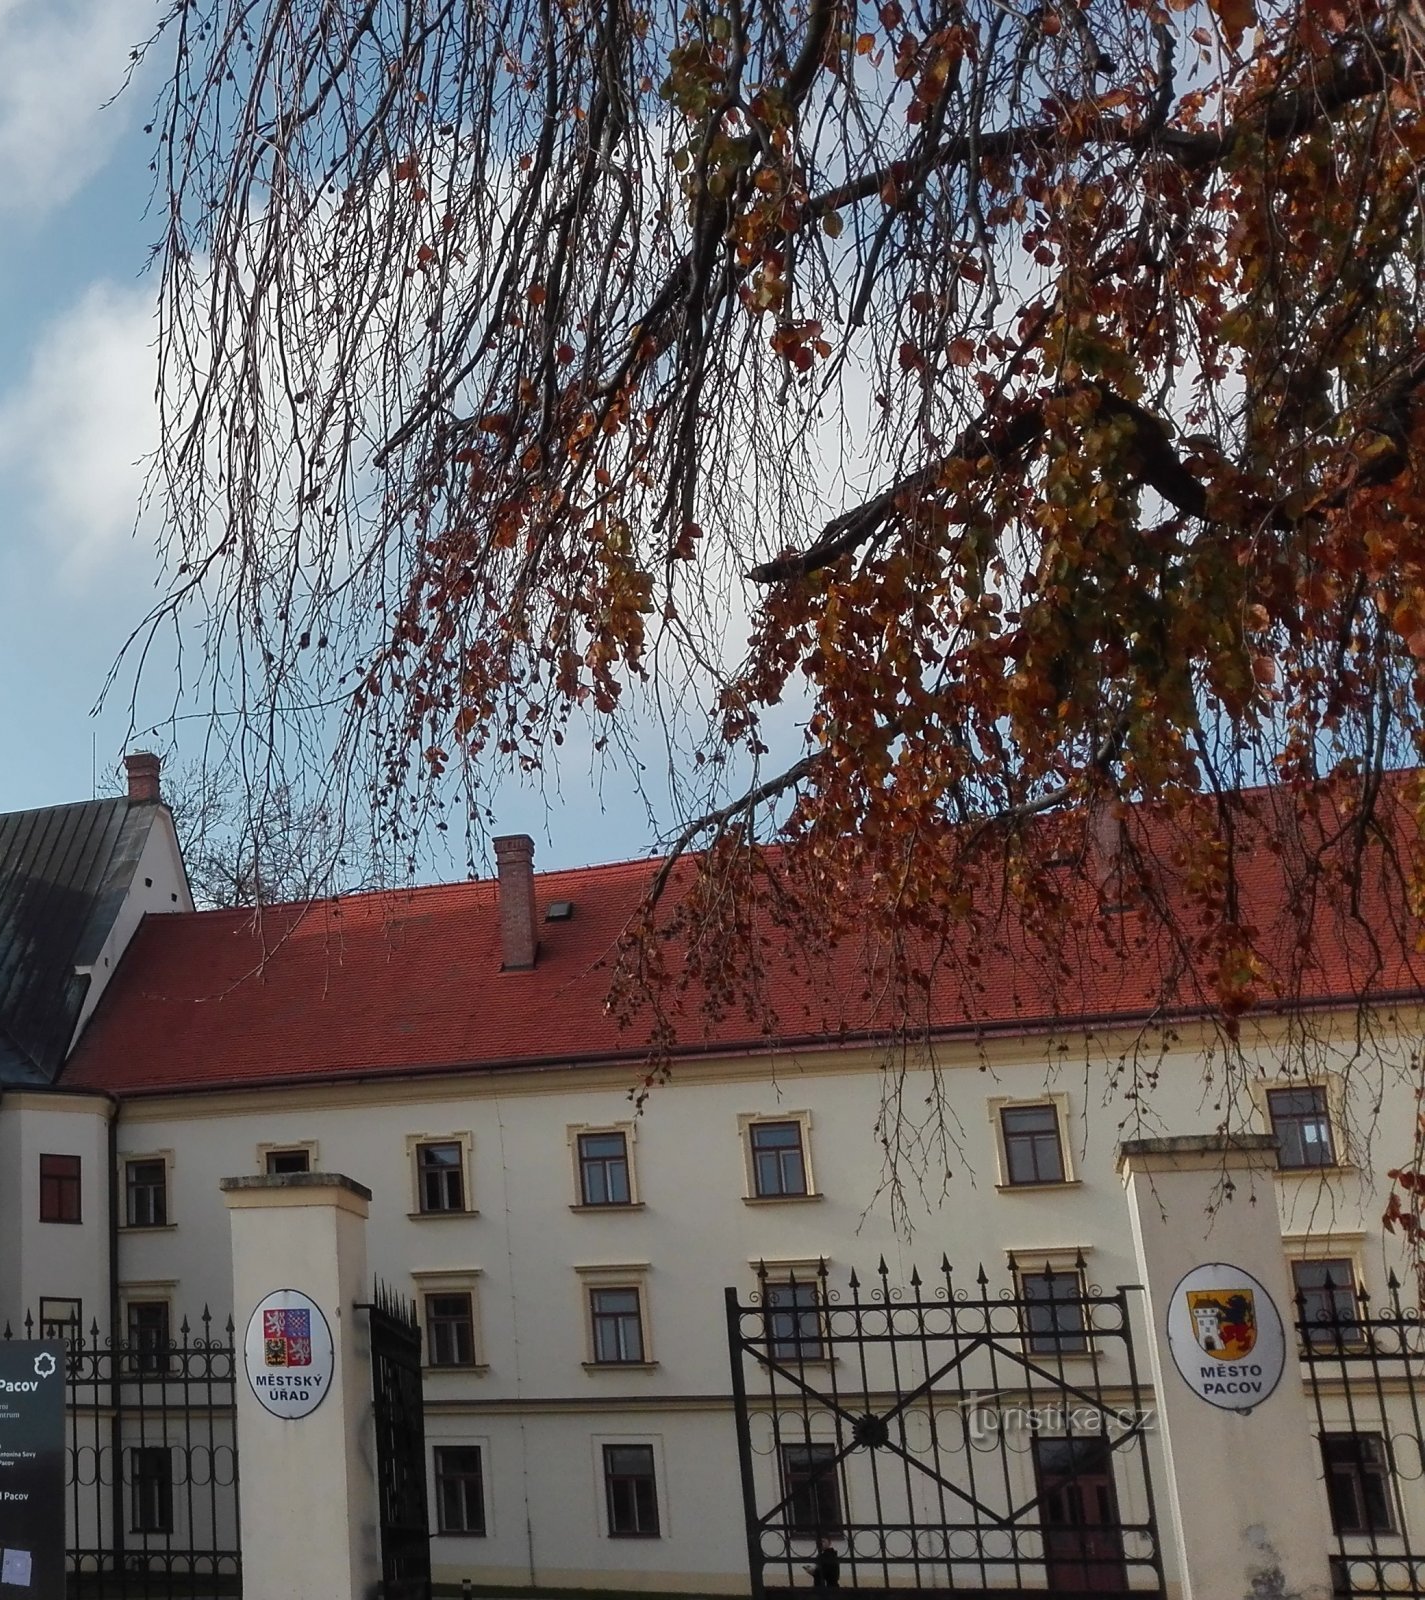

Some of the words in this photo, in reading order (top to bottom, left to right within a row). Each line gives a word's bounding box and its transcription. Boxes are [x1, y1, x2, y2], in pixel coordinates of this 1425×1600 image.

[1200, 1364, 1262, 1378] MĚSTO
[256, 1374, 322, 1386] MĚSTSKÝ
[270, 1388, 309, 1401] ÚŘAD
[1203, 1382, 1262, 1395] PACOV
[4, 1492, 29, 1500] Pacov
